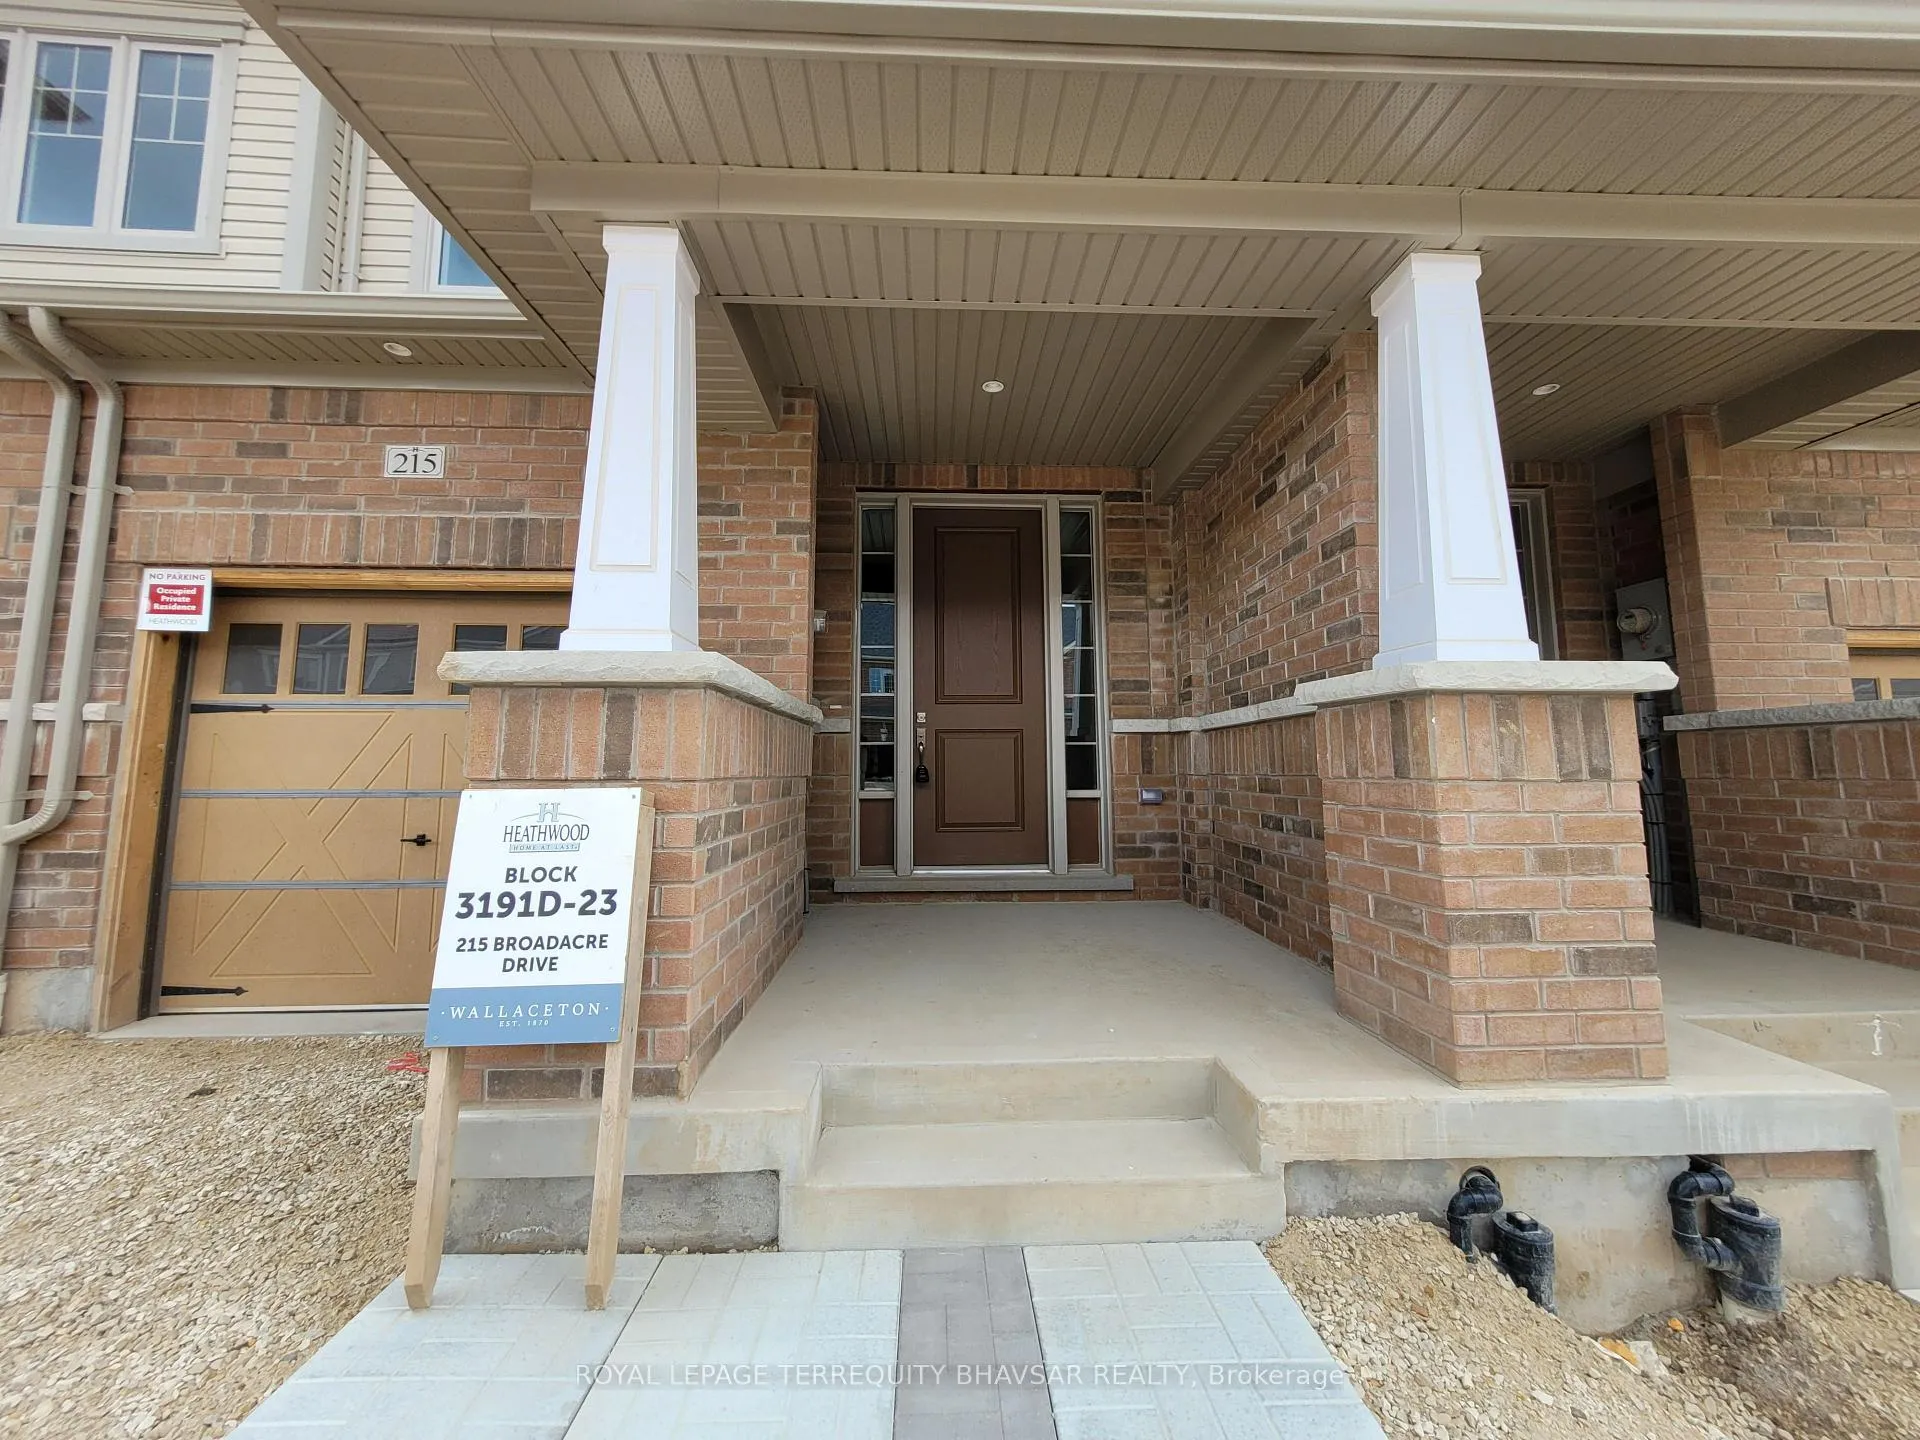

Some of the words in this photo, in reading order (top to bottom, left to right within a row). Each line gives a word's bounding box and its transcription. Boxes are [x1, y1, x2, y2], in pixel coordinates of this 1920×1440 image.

[392, 453, 437, 473] 215
[166, 573, 206, 581] PARKING
[156, 586, 197, 595] Occupied
[160, 595, 191, 603] Private
[153, 602, 197, 611] Residence
[502, 824, 590, 843] HEATHWOOD
[504, 866, 578, 884] BLOCK
[455, 889, 618, 919] 3191D-23
[456, 937, 488, 952] 215
[493, 934, 608, 952] BROADACRE
[502, 957, 559, 973] DRIVE
[450, 1002, 601, 1019] WALLACETON
